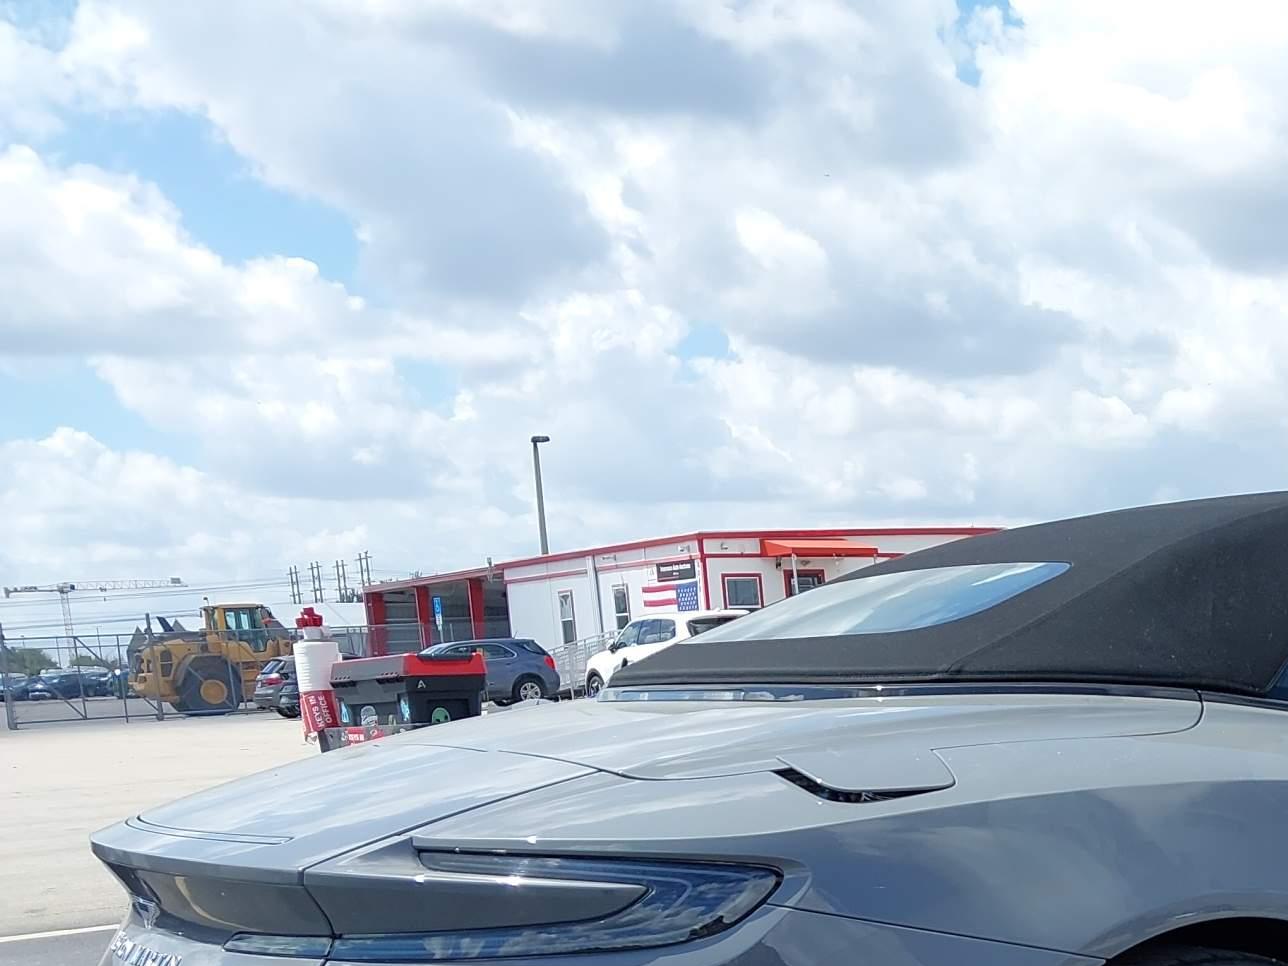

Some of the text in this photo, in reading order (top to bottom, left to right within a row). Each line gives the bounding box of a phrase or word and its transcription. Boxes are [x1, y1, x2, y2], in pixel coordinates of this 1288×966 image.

[308, 695, 325, 728] KEYS IN
[317, 695, 333, 724] OFFICE
